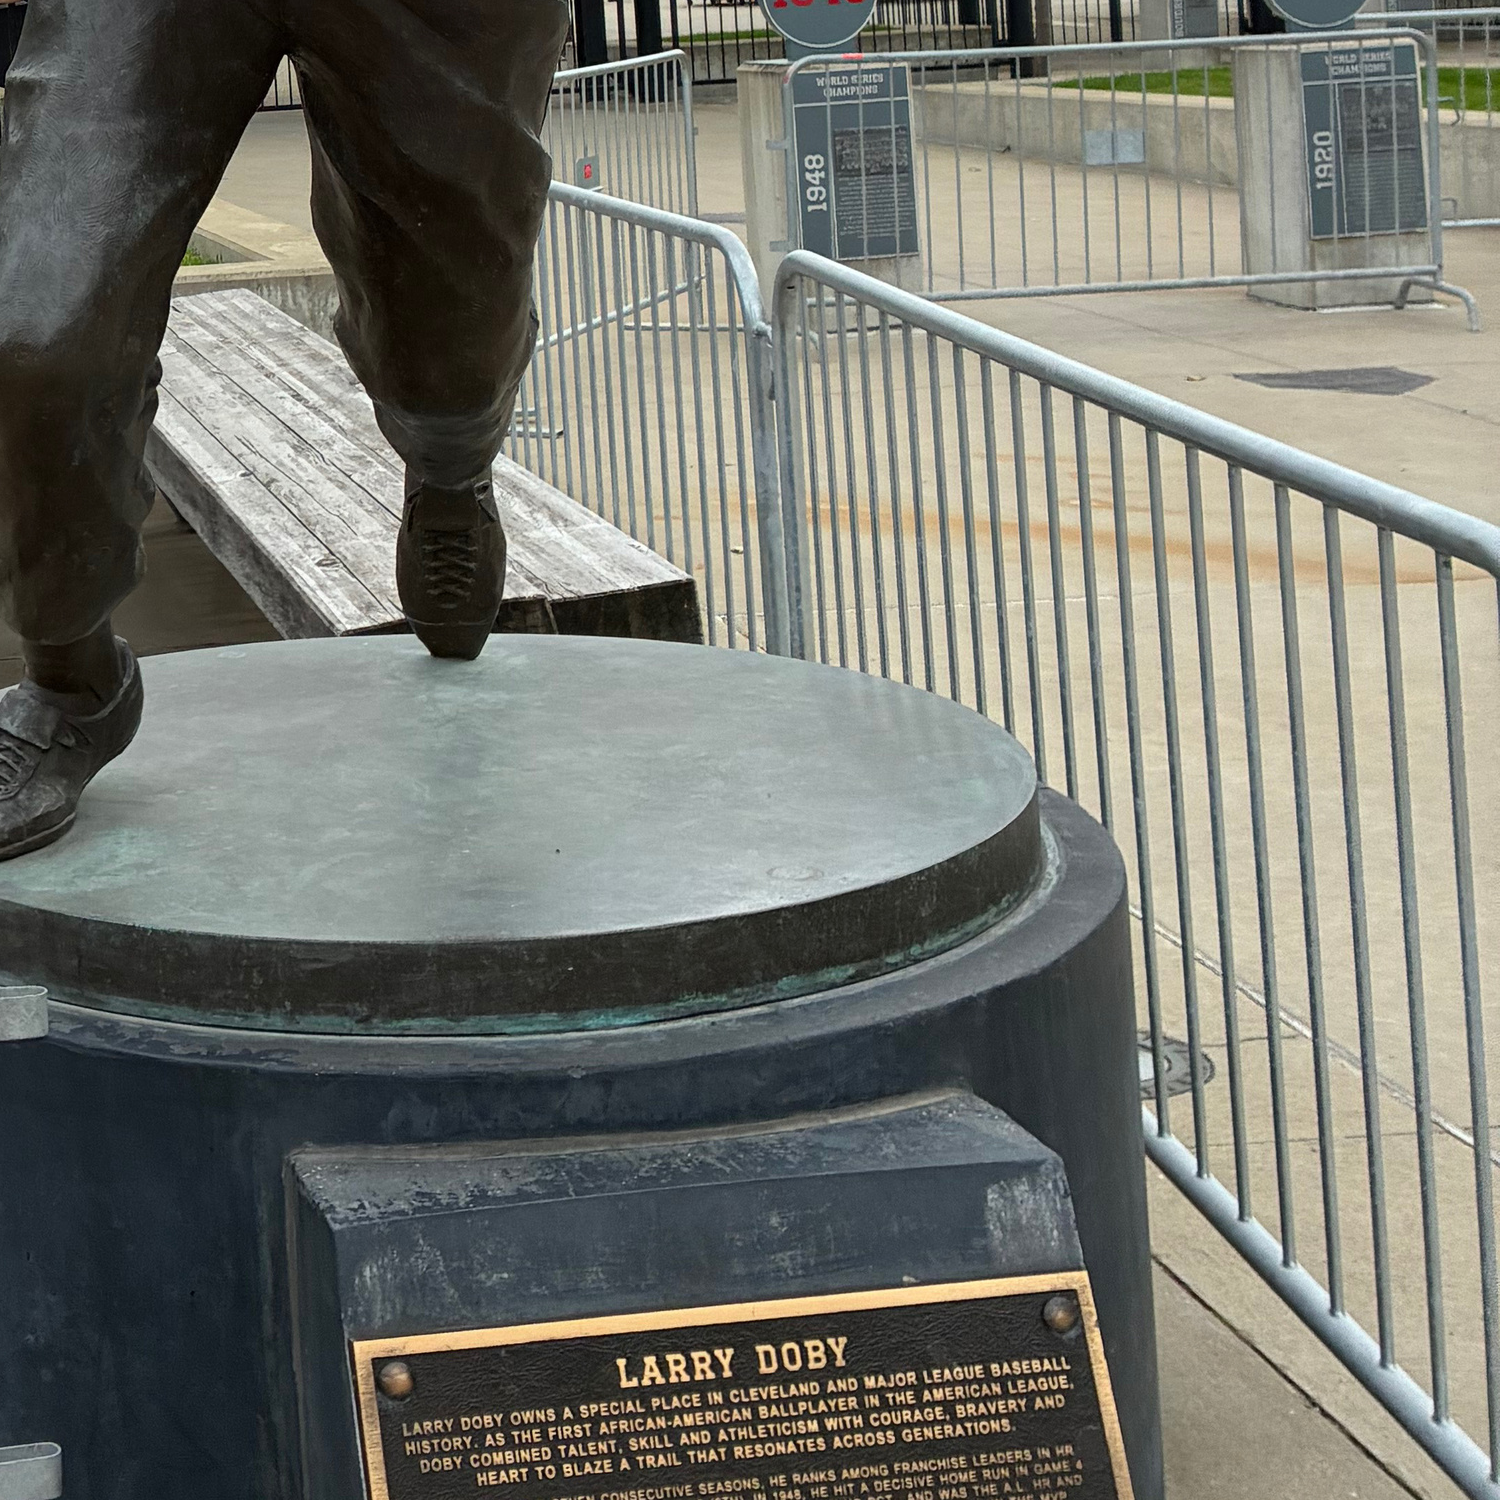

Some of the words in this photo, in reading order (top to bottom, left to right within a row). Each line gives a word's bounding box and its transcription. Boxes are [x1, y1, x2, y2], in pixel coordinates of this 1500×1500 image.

[1330, 62, 1387, 76] CHAMIONS
[804, 153, 828, 212] 1948
[1312, 131, 1334, 190] 1920
[615, 1347, 735, 1389] LARRY
[754, 1336, 848, 1375] DOBY
[402, 1418, 454, 1437] LARRY
[460, 1413, 504, 1431] DOBY
[509, 1407, 557, 1426] OWNS
[562, 1406, 574, 1421] A
[579, 1399, 646, 1419] SPECIAL
[651, 1393, 702, 1411] PLACE
[707, 1391, 724, 1406] IN
[729, 1381, 821, 1403] CLEVELAND
[826, 1377, 859, 1394] AND
[863, 1371, 918, 1389] MAJOR
[922, 1364, 985, 1384] LEAGUE
[989, 1355, 1071, 1377] BASEBALL
[485, 1432, 506, 1447] AS
[510, 1428, 543, 1445] THE
[547, 1423, 592, 1441] FIRST
[599, 1407, 753, 1436] AFRICAN-AMERICAN
[757, 1396, 859, 1419] BALLPLAYER
[863, 1393, 881, 1409] IN
[885, 1390, 917, 1406] THE
[922, 1382, 1003, 1403] AMERICAN
[1007, 1375, 1075, 1395] LEAGUE,
[419, 1455, 463, 1473] DOBY
[469, 1446, 552, 1468] COMBINED
[557, 1439, 623, 1459] TALENT,
[628, 1434, 674, 1451] SKILL
[679, 1429, 711, 1447] AND
[717, 1419, 820, 1443] ATHLETICISM
[823, 1414, 864, 1431] WITH
[869, 1406, 951, 1427] COURAGE,
[955, 1397, 1027, 1419] BRAVERY
[1034, 1393, 1065, 1411] AND
[476, 1467, 529, 1487] HEART
[533, 1464, 557, 1480] TO
[562, 1459, 614, 1478] BLAZE
[619, 1457, 631, 1471] A
[635, 1452, 683, 1469] TRAIL
[686, 1447, 727, 1464] THAT
[733, 1437, 827, 1460] RESONATES
[833, 1429, 896, 1450] ACROSS
[901, 1418, 1016, 1443] GENERATIONS.
[600, 1484, 694, 1500] CONSECUTIVE
[769, 1474, 788, 1487] HE
[791, 1469, 837, 1485] RANKS
[841, 1464, 889, 1480] AMONG
[893, 1455, 968, 1475] FRANCHISE
[972, 1449, 1033, 1467] LEADERS
[1037, 1447, 1051, 1459] IN
[1055, 1444, 1074, 1457] HR
[810, 1485, 829, 1499] HE
[833, 1483, 855, 1496] HIT
[860, 1482, 869, 1494] A
[873, 1475, 935, 1492] DECISIVE
[939, 1470, 977, 1485] HOME
[981, 1467, 1010, 1480] RUN
[1015, 1464, 1029, 1477] IN
[1033, 1460, 1070, 1475] GAME
[907, 1490, 933, 1500] AND
[938, 1486, 968, 1500] WAS
[972, 1483, 998, 1497] THE
[1033, 1478, 1051, 1490] HR
[1057, 1474, 1083, 1487] AND
